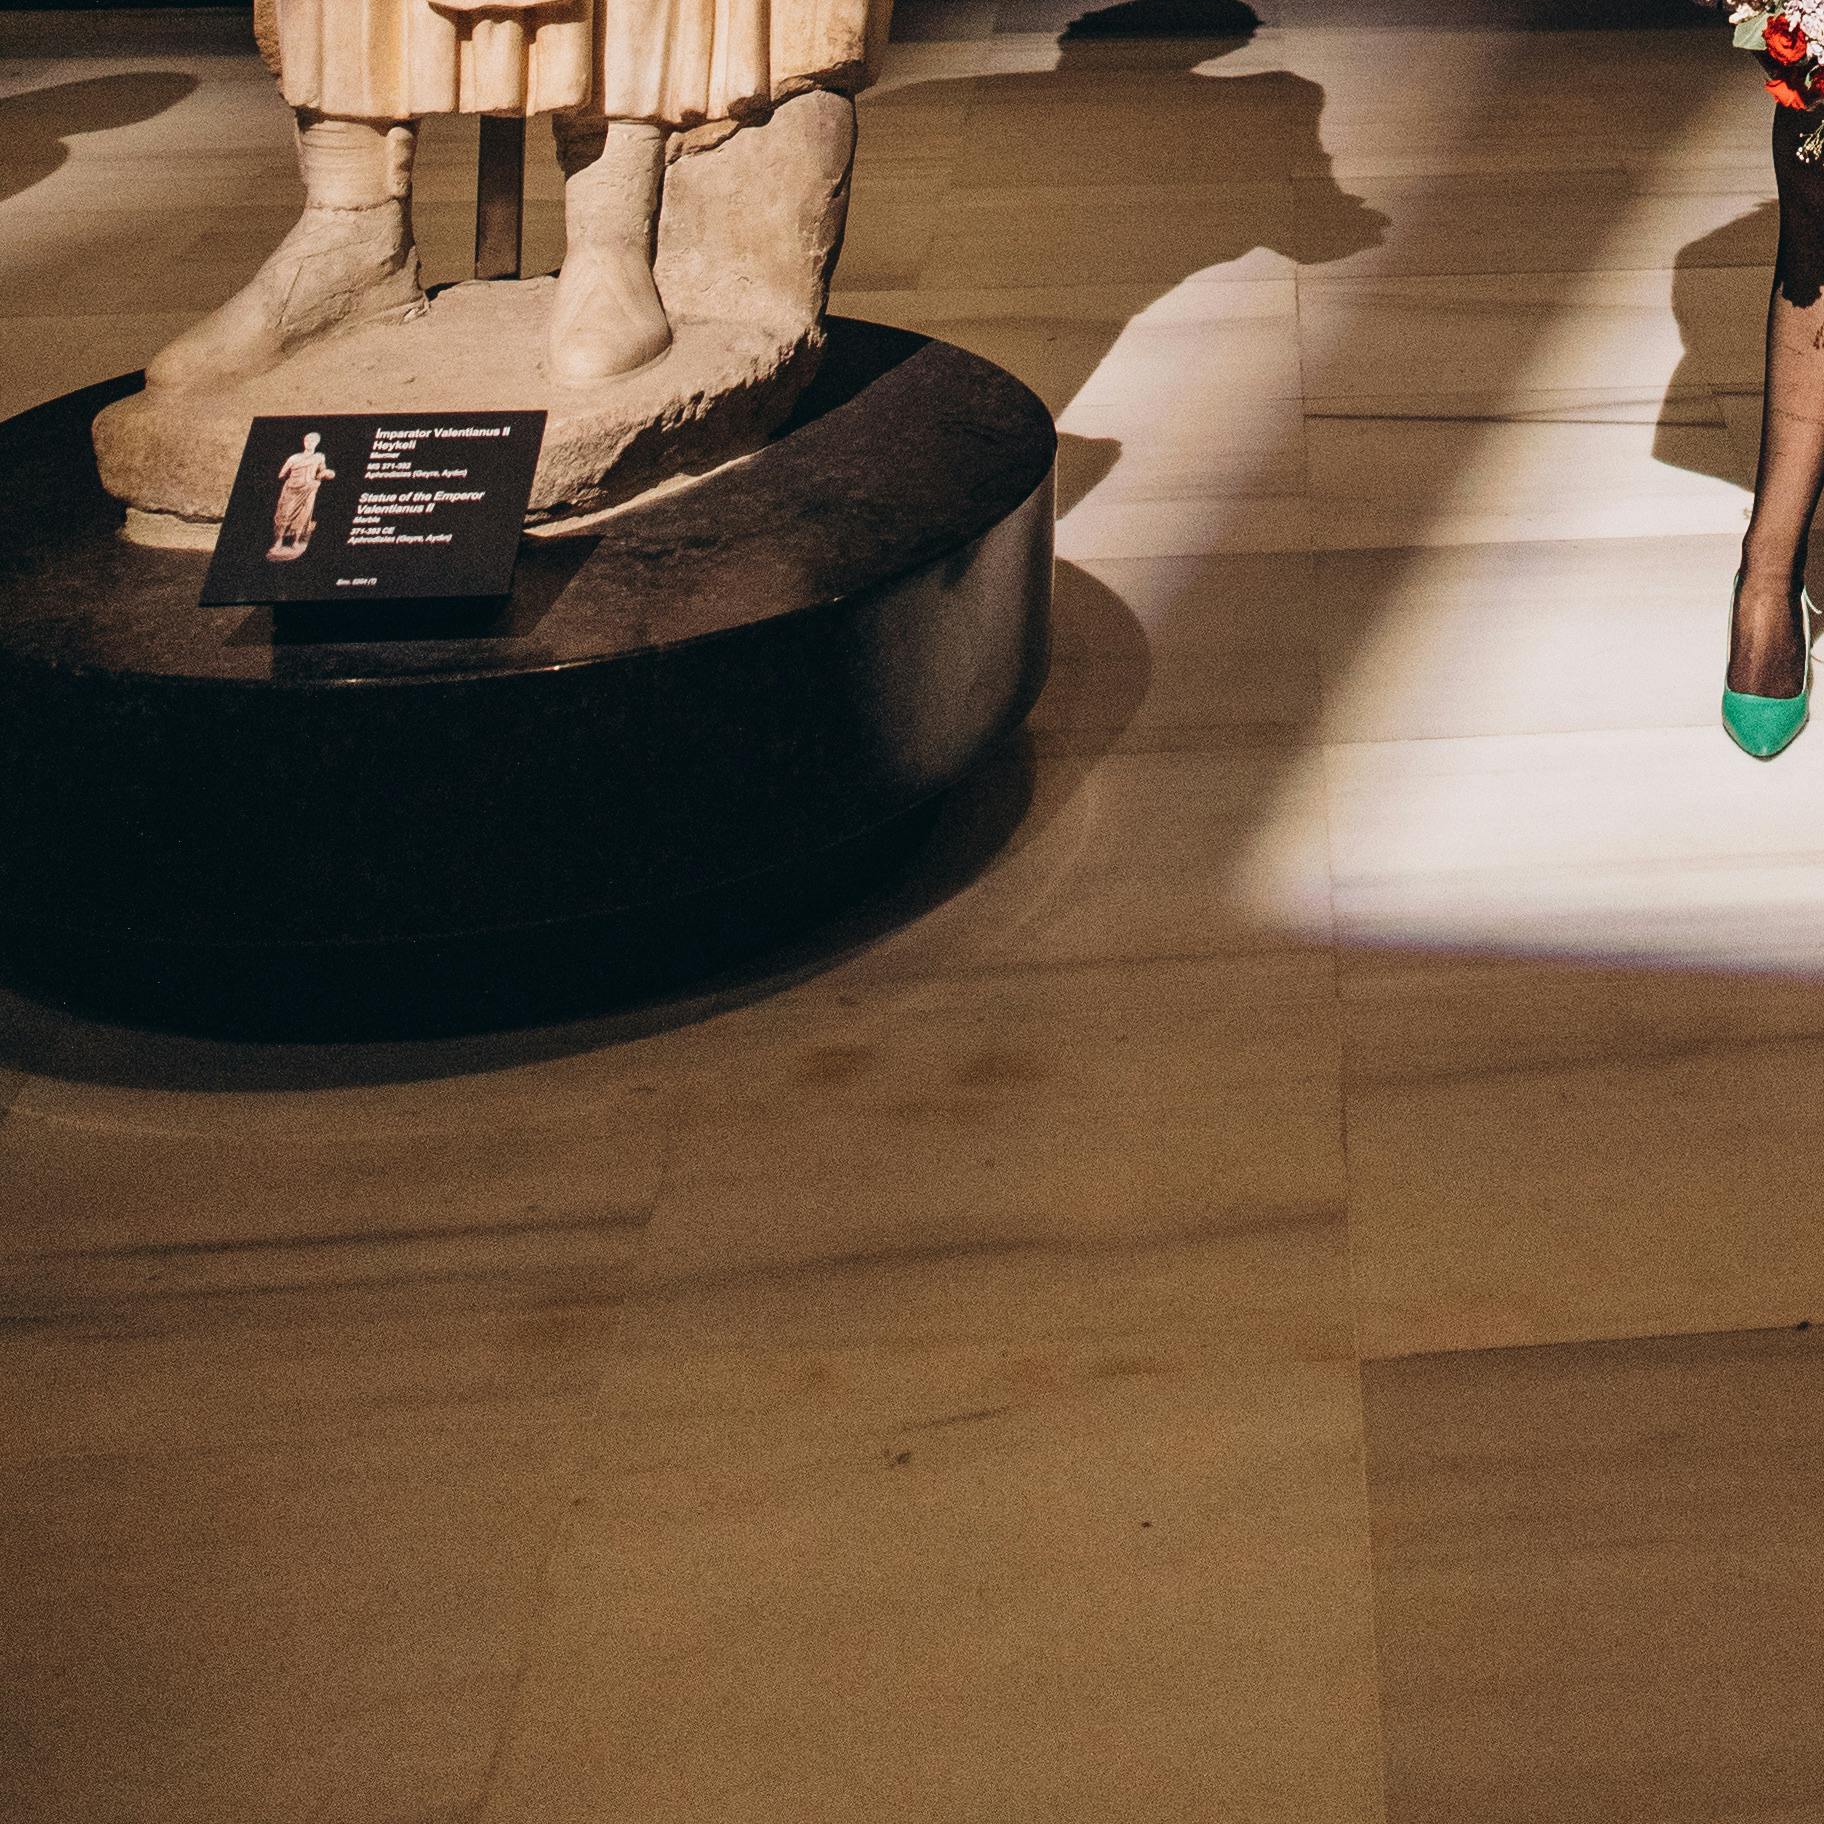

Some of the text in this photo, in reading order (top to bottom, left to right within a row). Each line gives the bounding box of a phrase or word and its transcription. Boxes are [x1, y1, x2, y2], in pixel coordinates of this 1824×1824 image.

[502, 426, 511, 437] II
[373, 440, 417, 452] Heykeli
[360, 491, 486, 503] Statue of the Emperor
